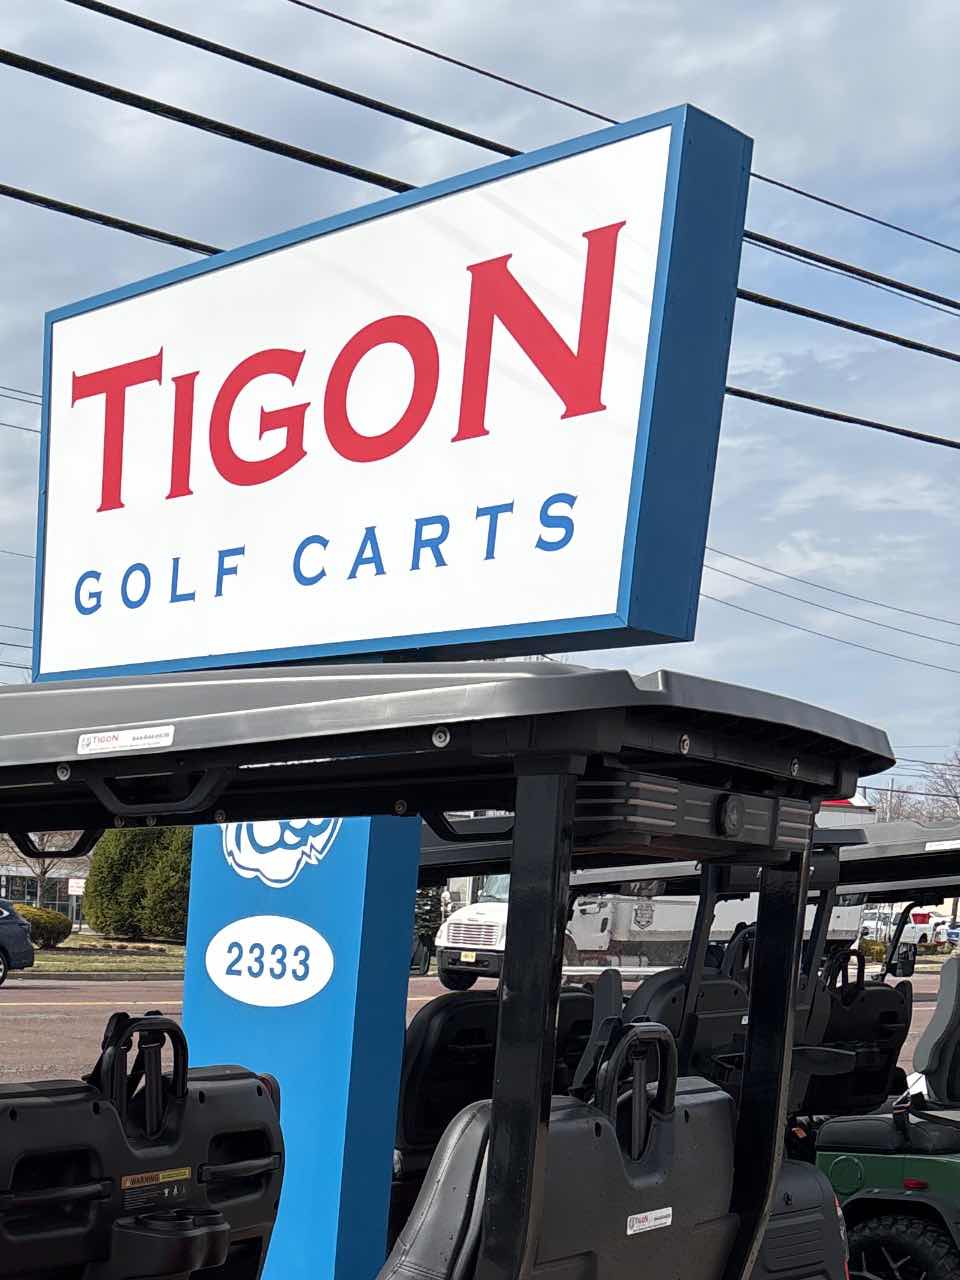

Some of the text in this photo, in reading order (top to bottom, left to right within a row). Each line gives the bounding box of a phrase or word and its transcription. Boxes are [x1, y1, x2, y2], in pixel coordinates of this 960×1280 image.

[71, 220, 627, 512] TIGON
[74, 493, 578, 615] GOLF CARTS
[225, 941, 310, 982] 2333
